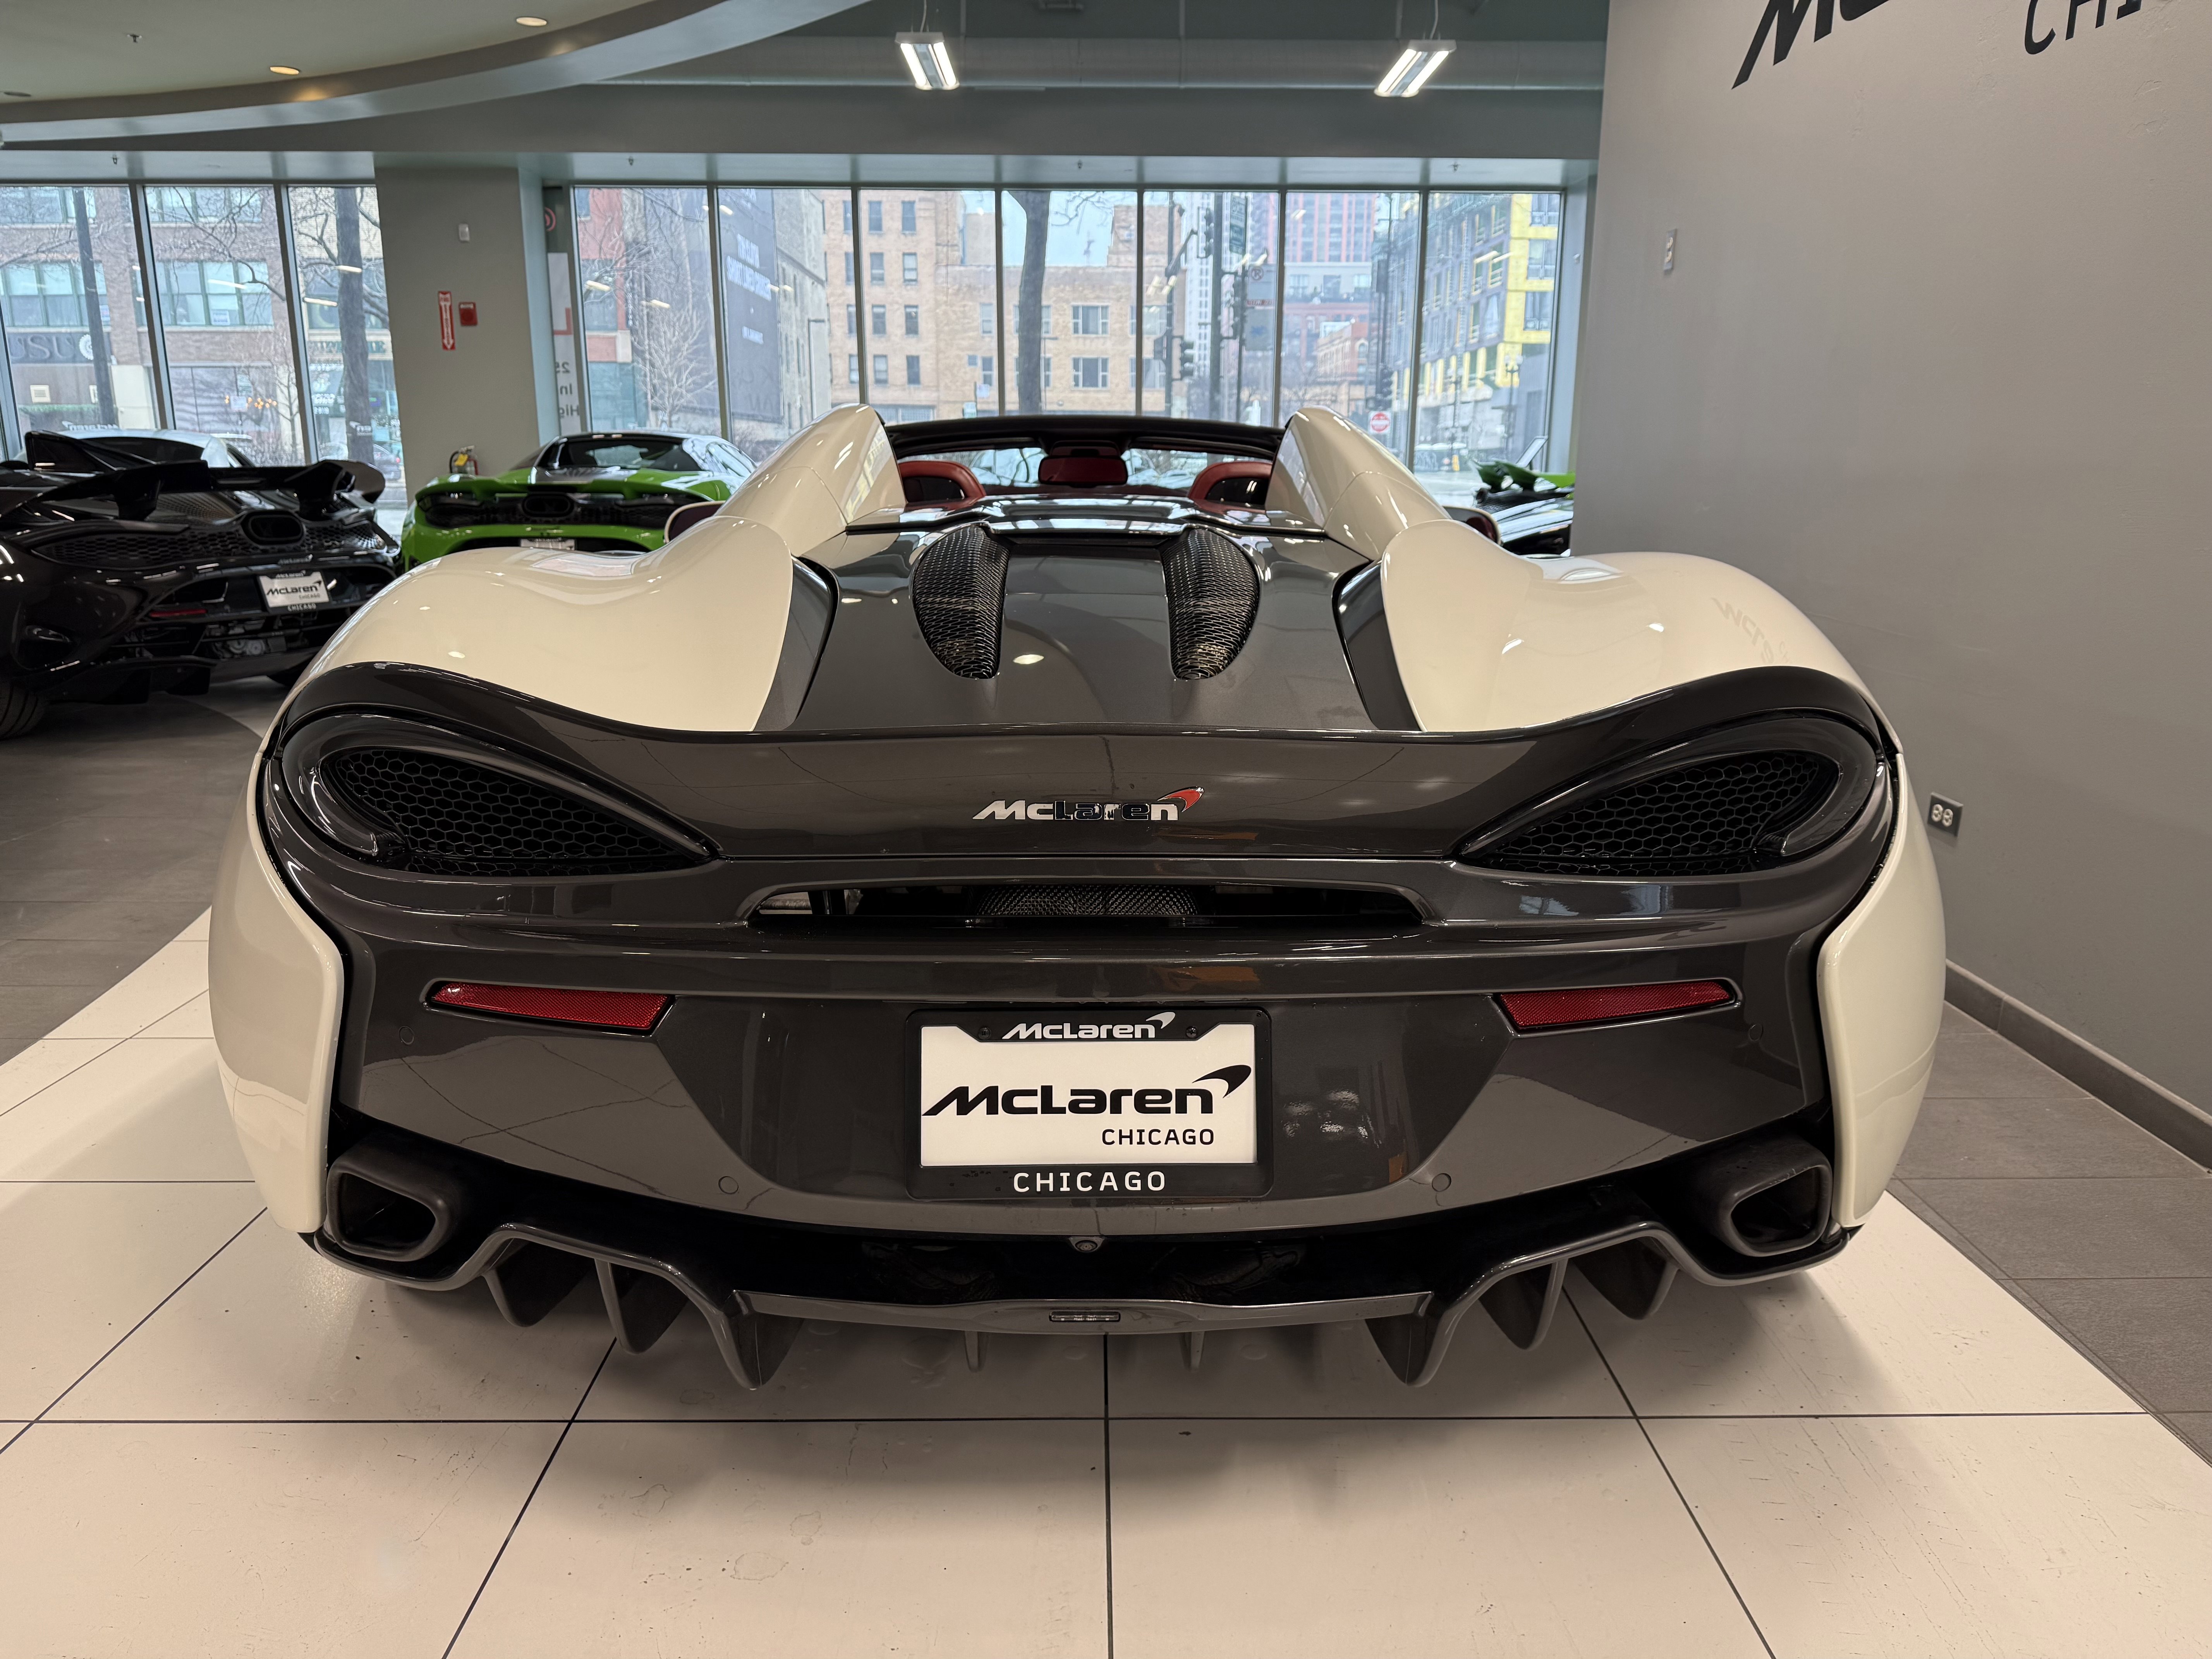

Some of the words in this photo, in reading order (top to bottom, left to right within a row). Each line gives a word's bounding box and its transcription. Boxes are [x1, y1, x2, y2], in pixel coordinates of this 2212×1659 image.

[267, 585, 318, 596] McLaren
[287, 603, 316, 611] CHICAGO
[972, 800, 1178, 820] McLaren
[1002, 1023, 1155, 1039] McLaren
[922, 1085, 1214, 1116] McLaren
[1102, 1128, 1214, 1146] CHICAGO
[1013, 1171, 1166, 1193] CHICAGO
